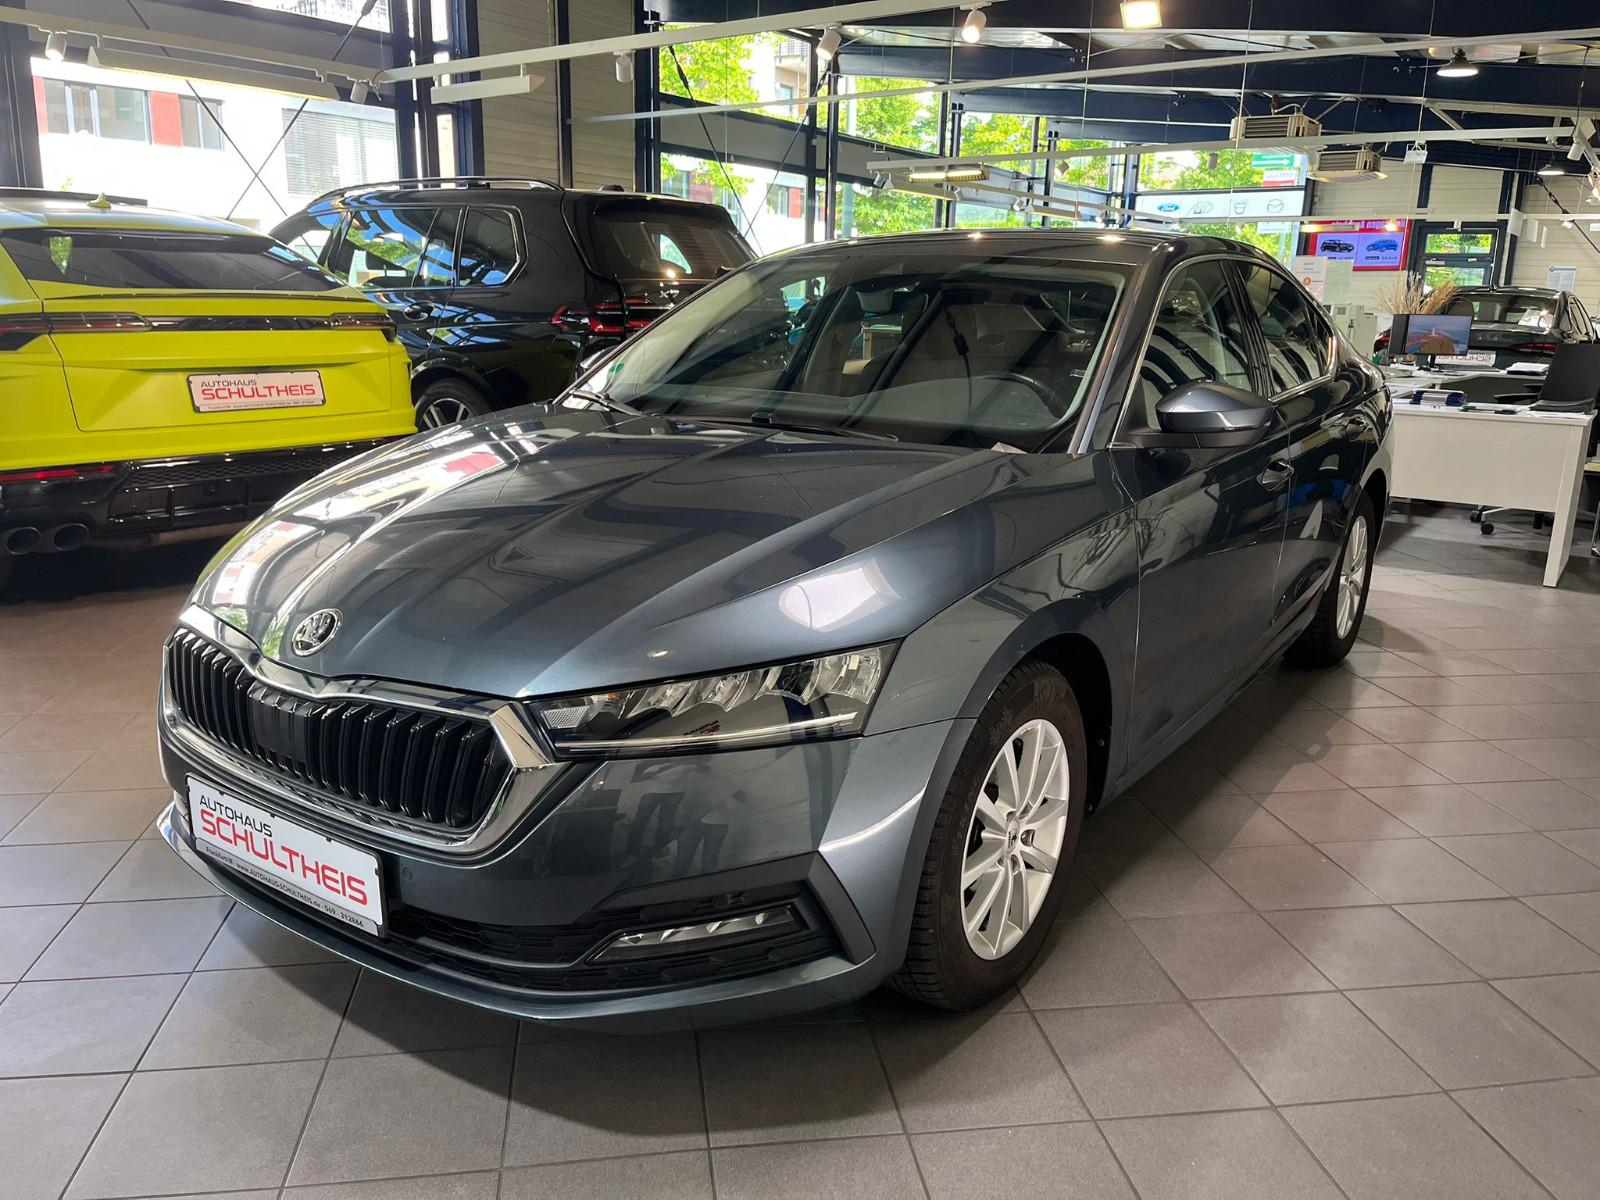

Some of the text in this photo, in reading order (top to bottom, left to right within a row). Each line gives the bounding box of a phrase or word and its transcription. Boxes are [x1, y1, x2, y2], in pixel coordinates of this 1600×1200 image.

[659, 289, 680, 298] X7
[200, 379, 257, 388] AUTOHAUS
[201, 384, 316, 400] SCHULTHEIS
[199, 794, 273, 838] AUTOHAUS
[200, 808, 368, 906] SCHULTHEIS
